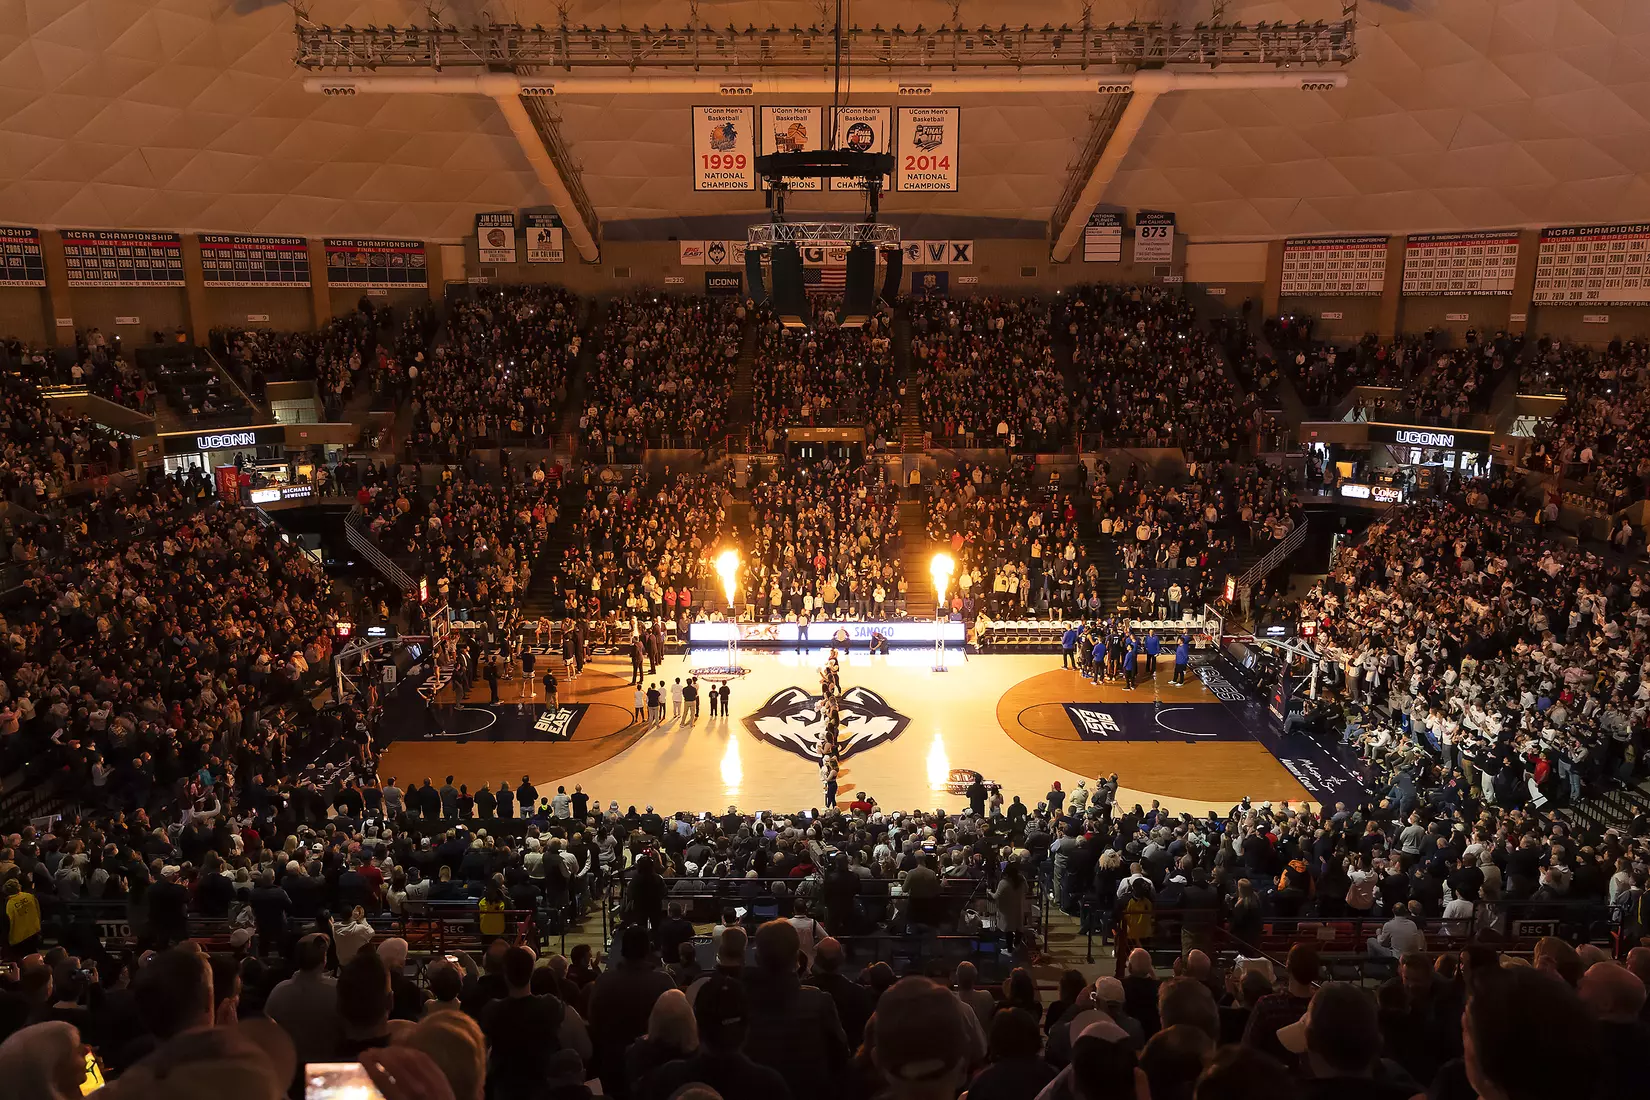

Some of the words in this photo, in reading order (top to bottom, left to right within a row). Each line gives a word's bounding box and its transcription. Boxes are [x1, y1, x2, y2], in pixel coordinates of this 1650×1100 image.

[702, 155, 747, 169] 1999
[905, 156, 950, 170] 2014
[1142, 227, 1167, 237] 873
[953, 245, 969, 261] X
[197, 432, 256, 449] UCONN
[1396, 430, 1454, 447] UCONN
[1371, 486, 1398, 498] Coke
[855, 627, 895, 637] SANOGO
[534, 712, 556, 731] BIG
[547, 708, 572, 734] EAST
[1079, 709, 1108, 736] EAST
[1094, 712, 1120, 731] BIG
[101, 924, 131, 937] 110
[444, 926, 464, 934] SEC
[1521, 926, 1542, 934] SEC
